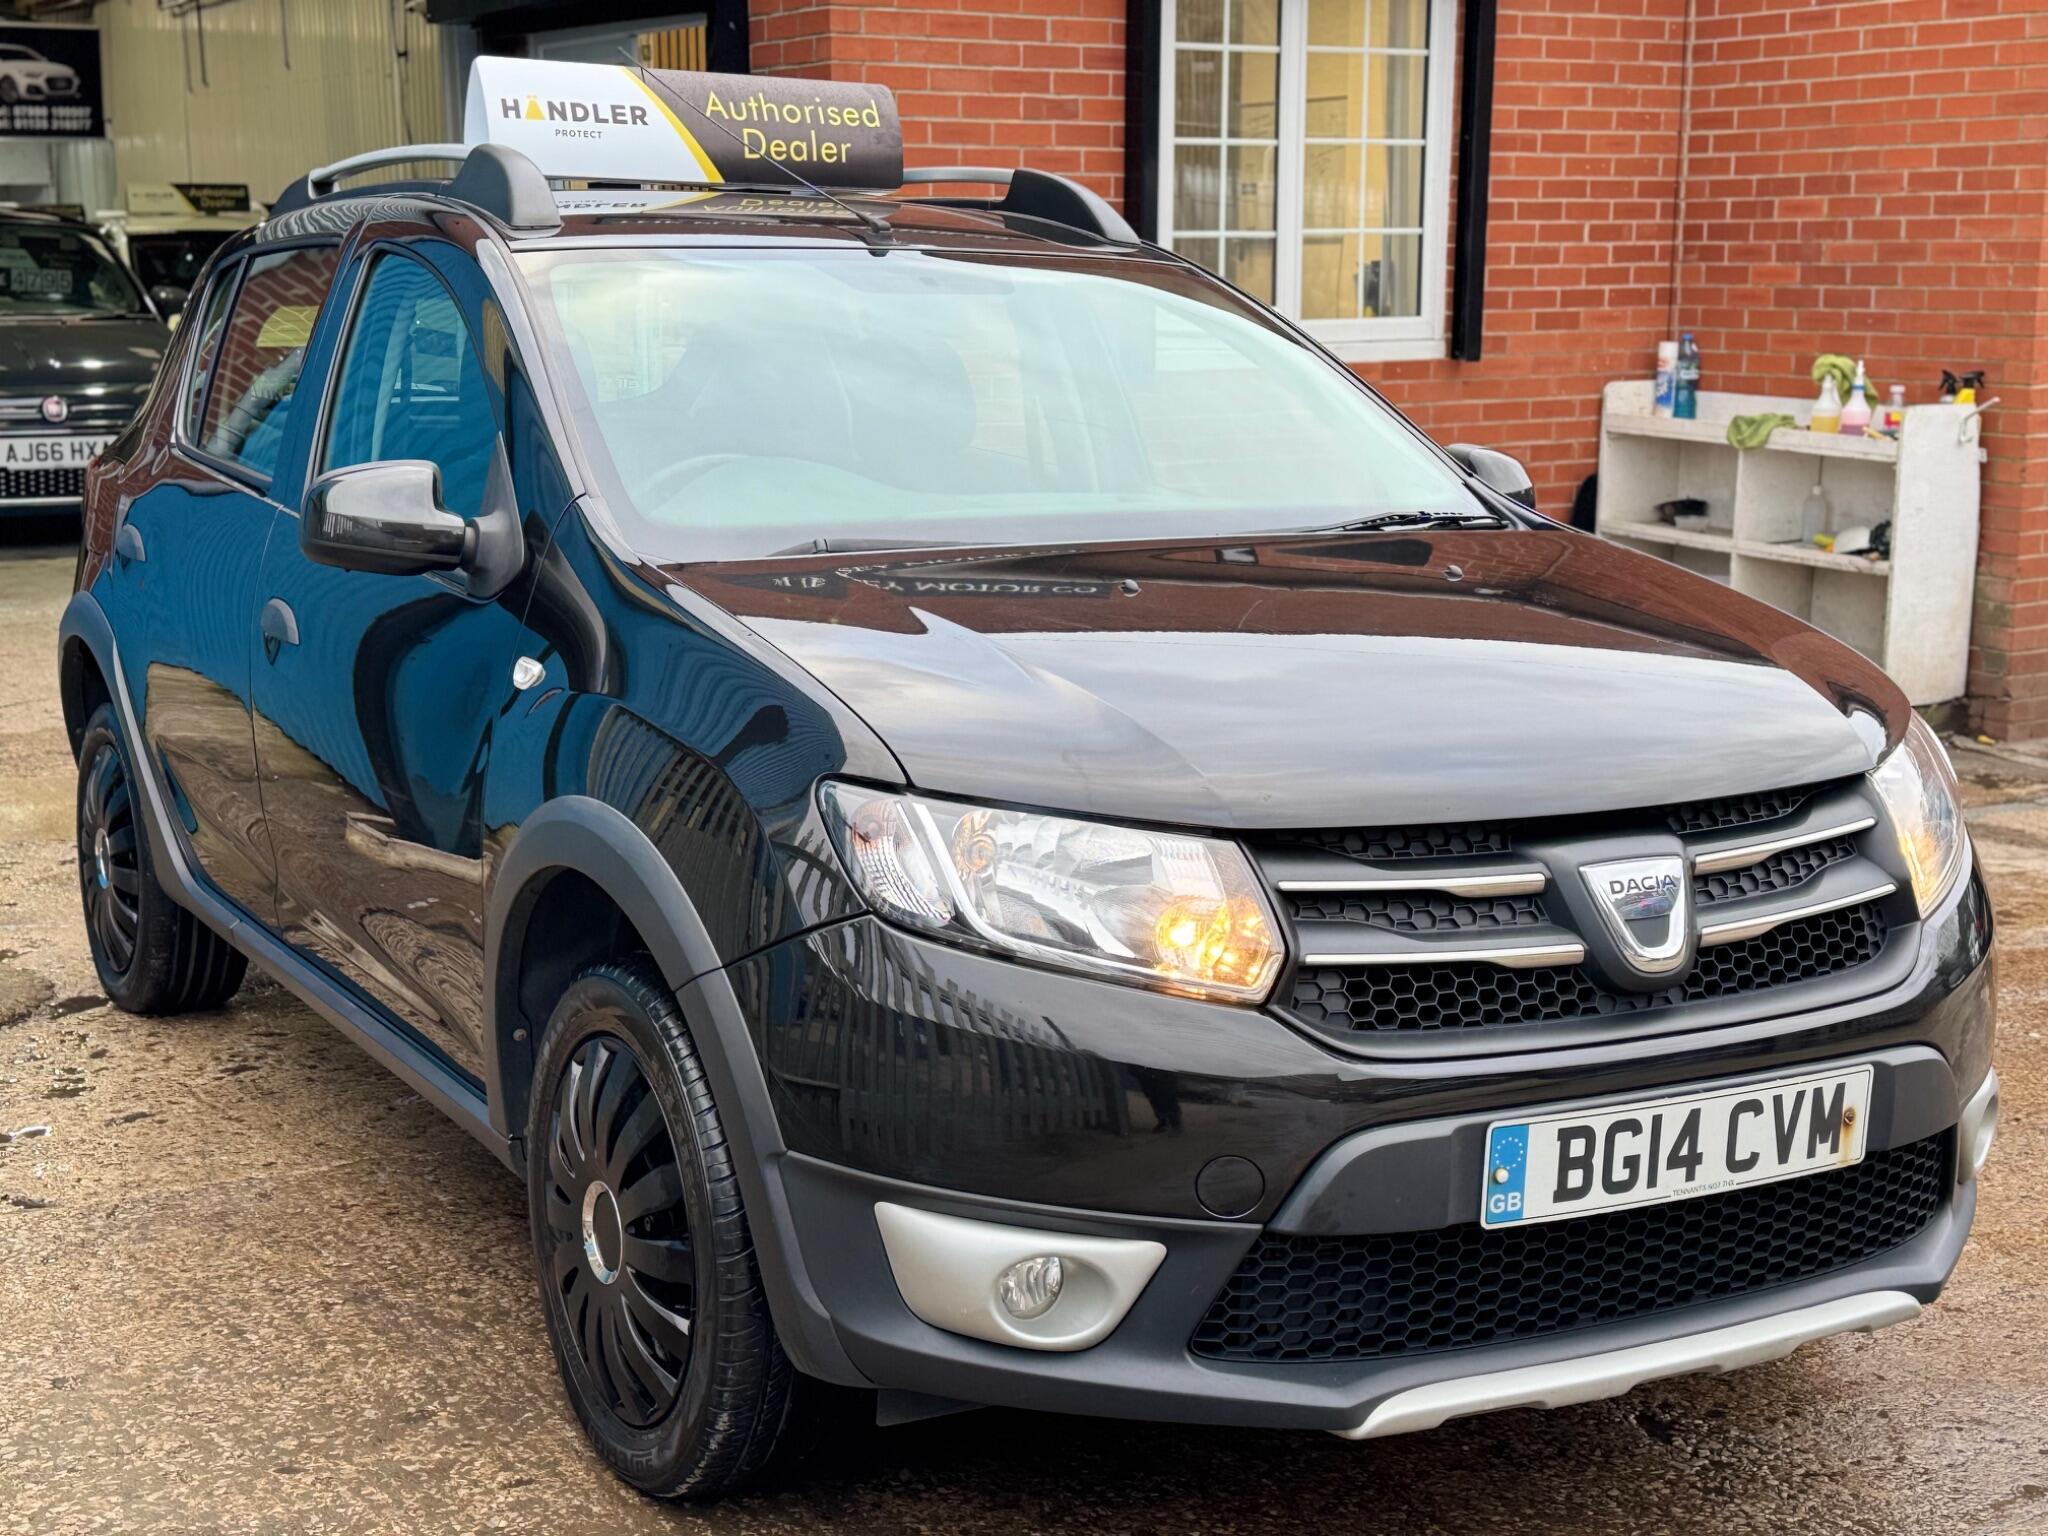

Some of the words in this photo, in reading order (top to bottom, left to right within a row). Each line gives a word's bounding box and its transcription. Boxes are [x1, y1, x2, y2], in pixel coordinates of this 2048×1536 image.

[705, 91, 881, 129] Authorised
[555, 129, 602, 139] PROTECT
[743, 128, 852, 164] Dealer
[6, 442, 64, 463] AJ66
[1609, 874, 1677, 895] DACIA
[1553, 1108, 1703, 1204] BG14
[1725, 1082, 1846, 1174] CVM
[1489, 1194, 1523, 1214] GB
